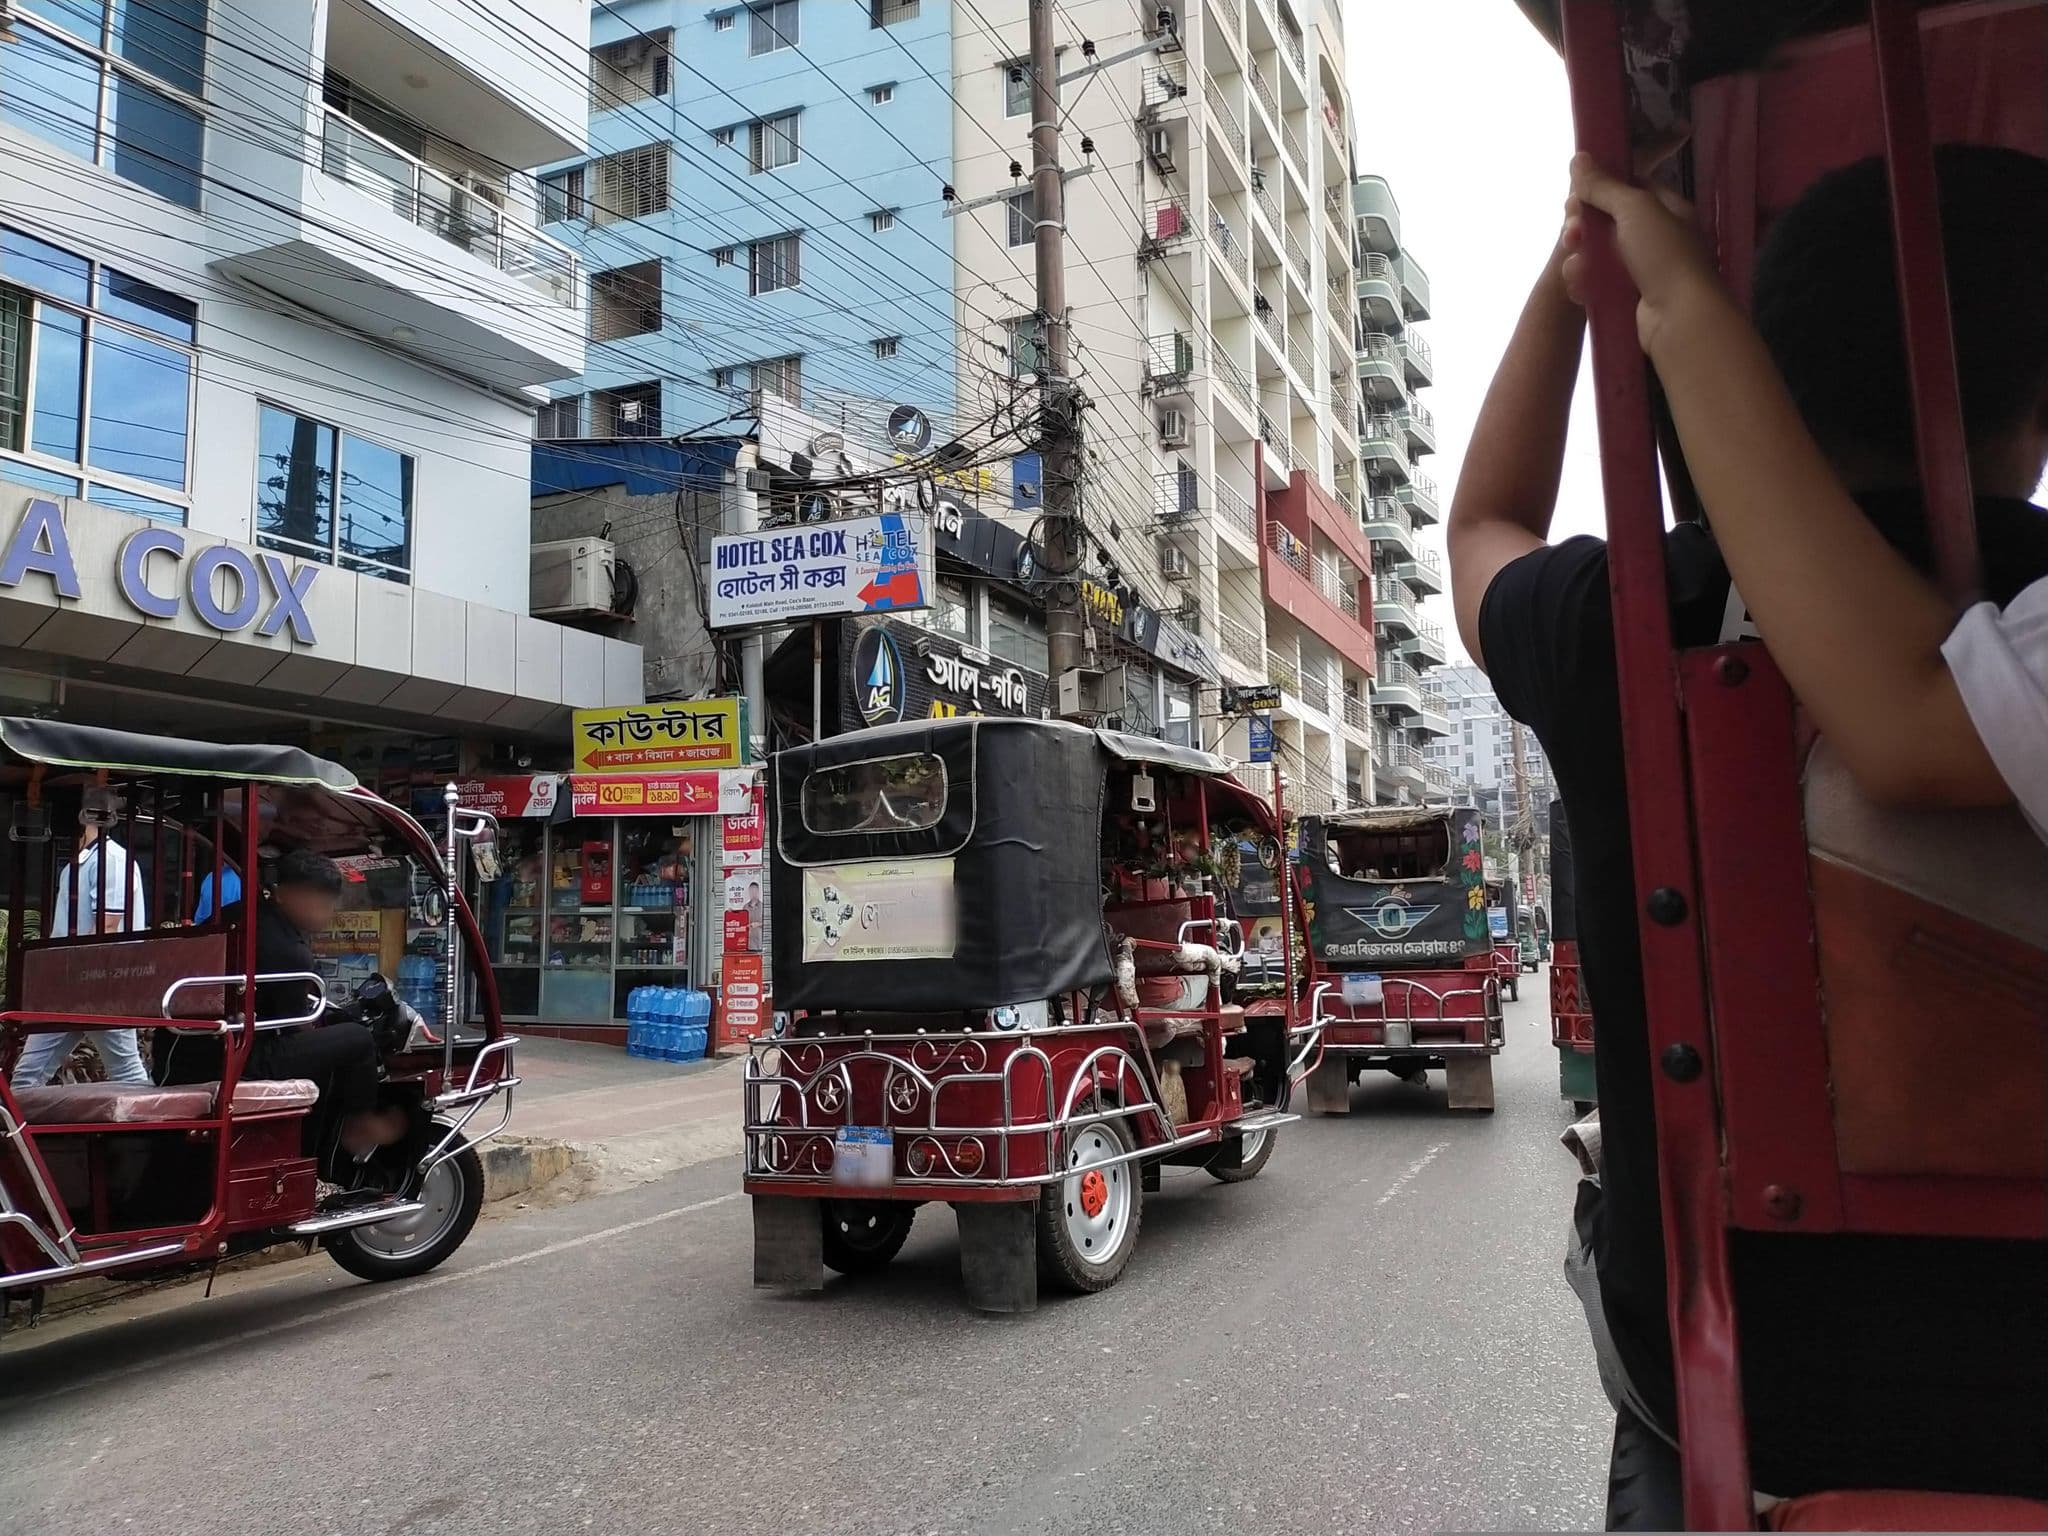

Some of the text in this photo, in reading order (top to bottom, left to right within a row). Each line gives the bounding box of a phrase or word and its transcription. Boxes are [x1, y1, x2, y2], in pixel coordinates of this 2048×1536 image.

[716, 529, 847, 570] HOTEL SEA COX
[856, 546, 918, 562] SEA COX
[0, 498, 320, 645] A COX
[717, 564, 847, 599] হোটেল সী কক্স
[868, 686, 891, 708] AG
[582, 708, 729, 746] কাউন্টার
[614, 746, 721, 763] বাস বিমান জাহাজ
[1324, 943, 1339, 956] কে
[1357, 938, 1402, 956] বিজনেস
